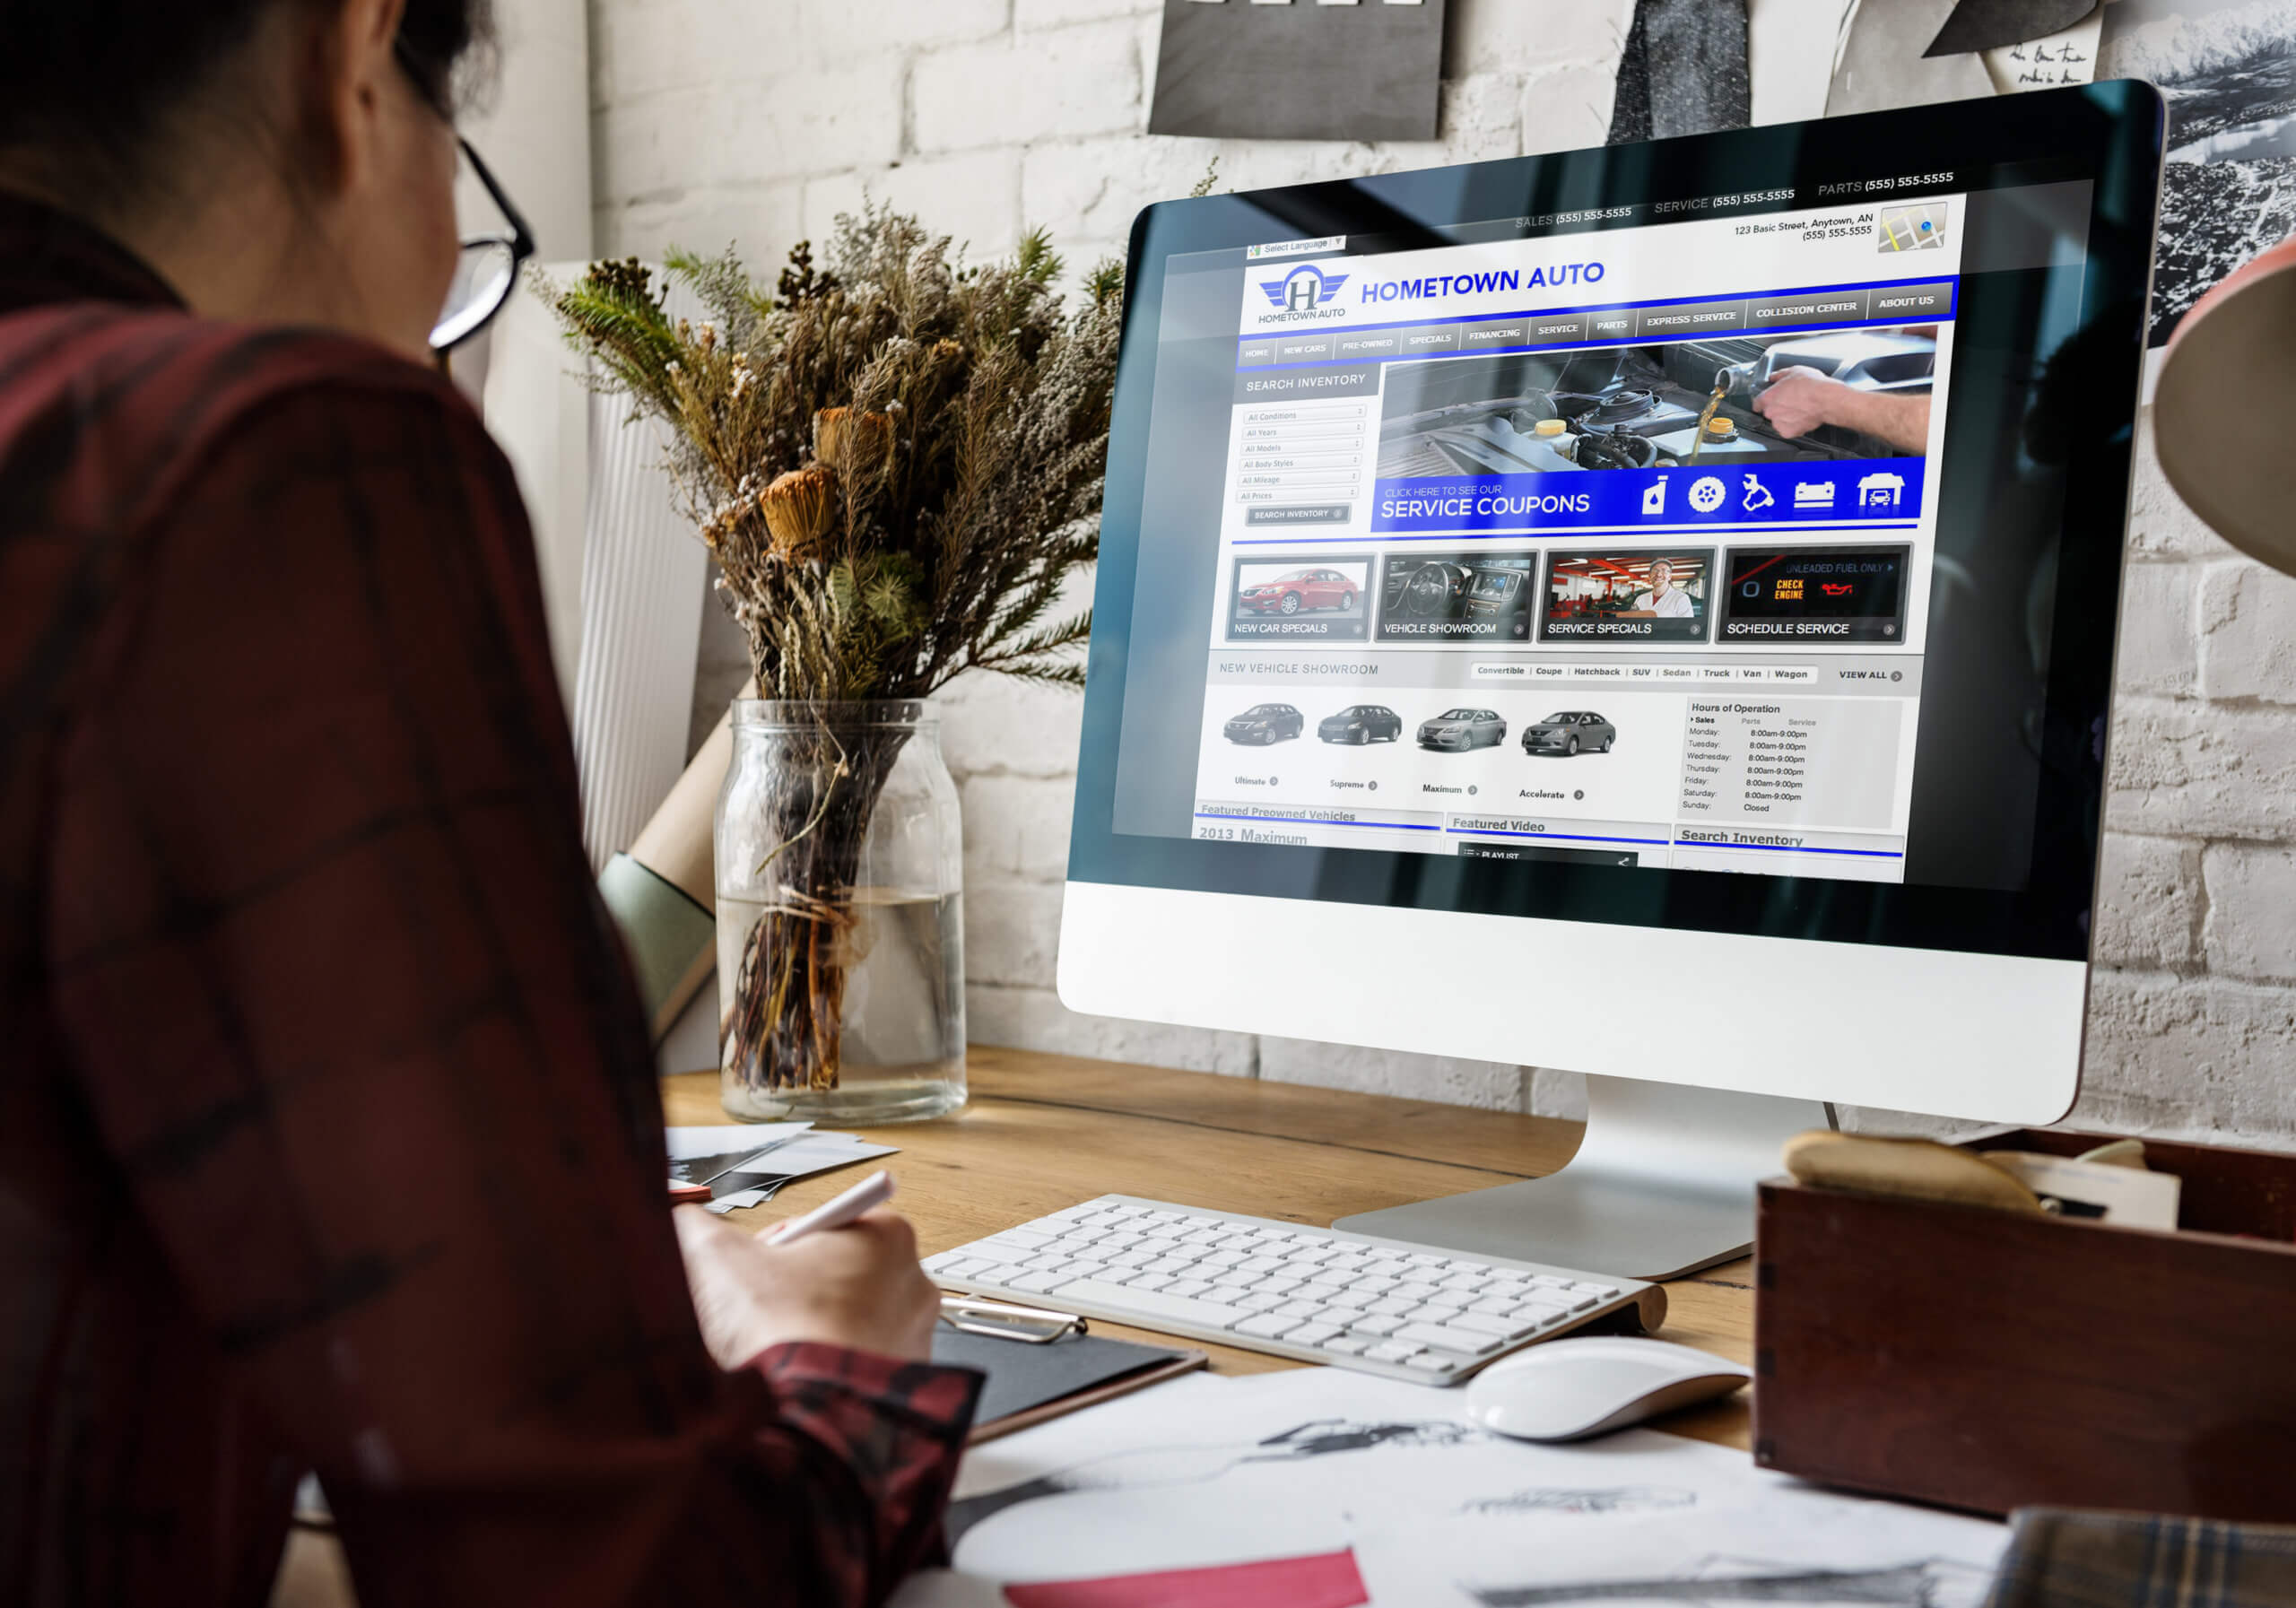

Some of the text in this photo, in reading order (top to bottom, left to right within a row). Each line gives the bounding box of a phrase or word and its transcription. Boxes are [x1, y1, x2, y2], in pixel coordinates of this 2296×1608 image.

[1818, 172, 1954, 196] PARTS (555) 555-5555
[1655, 189, 1795, 213] SERVICE (555) 555-5555
[1515, 207, 1632, 229] SALES (555) 555-5555
[1735, 213, 1873, 236] 123 Basic Street, Anytown, AN
[1803, 226, 1872, 241] (555) 555-5555
[1265, 239, 1327, 253] Select Language
[1361, 262, 1605, 303] HOMETOWN AUTO
[1879, 296, 1935, 309] ABOUT US
[1756, 302, 1857, 317] COLLISION CENTER
[1258, 308, 1345, 324] HOMETOWN AUTO
[1647, 312, 1736, 326] EXPRESS SERVICE
[1538, 324, 1578, 335] SERVICE
[1596, 320, 1628, 331] PARTS
[1469, 328, 1520, 340] FINANCING
[1343, 339, 1393, 350] PRE-OWNED
[1409, 335, 1451, 345] SPECIALS
[1245, 348, 1269, 358] HOME
[1283, 343, 1327, 355] NEW CARS
[1247, 373, 1366, 392] SEARCH INVENTORY
[1248, 410, 1297, 422] All Conditions
[1245, 444, 1282, 453] All Models
[1255, 461, 1272, 469] Body
[1273, 459, 1294, 468] Styles
[1242, 475, 1281, 485] All Mileage
[1241, 492, 1251, 500] All
[1385, 484, 1503, 499] CLICK HERE TO SEE OUR
[1381, 493, 1591, 518] SERVICE COUPONS
[1255, 509, 1329, 519] SEARCH INVENTORY
[1787, 563, 1883, 574] UNLEADED FUEL ONLY
[1777, 579, 1804, 589] CHECK
[1774, 589, 1804, 600] ENGINE
[1234, 623, 1327, 634] NEW CAR SPECIALS
[1384, 623, 1497, 634] VEHICLE SHOWROOM
[1548, 623, 1652, 635] SERVICE SPECIALS
[1726, 623, 1849, 634] SCHEDULE SERVICE
[1220, 663, 1378, 675] NEW VEHICLE SHOWROOM
[1477, 666, 1808, 680] Convertible Coupe Hatchback SUV Sedan Truck Van Wagon
[1839, 670, 1887, 680] VIEW ALL
[1692, 703, 1780, 714] Hours of Operation
[1788, 718, 1816, 726] Service
[1751, 730, 1807, 738] 8:00am-9:00pm
[1750, 742, 1806, 751] 8:00am-9:00pm
[1748, 754, 1805, 763] 8:00am-9:00pm
[1747, 767, 1804, 776] 8:00am-9:00pm
[1235, 776, 1266, 786] Ultimate
[1330, 779, 1364, 790] Supreme
[1746, 779, 1803, 788] 8:00am-9:00pm
[1422, 784, 1462, 794] Maximum
[1519, 789, 1565, 800] Accelerate
[1744, 792, 1802, 801] 8:00am-9:00pm
[1201, 804, 1356, 821] Featured Preowned Vehicles
[1744, 804, 1770, 812] Closed
[1453, 818, 1545, 832] Featured Video
[1199, 827, 1308, 845] 2013 Maximum
[1681, 830, 1804, 847] Search Inventory
